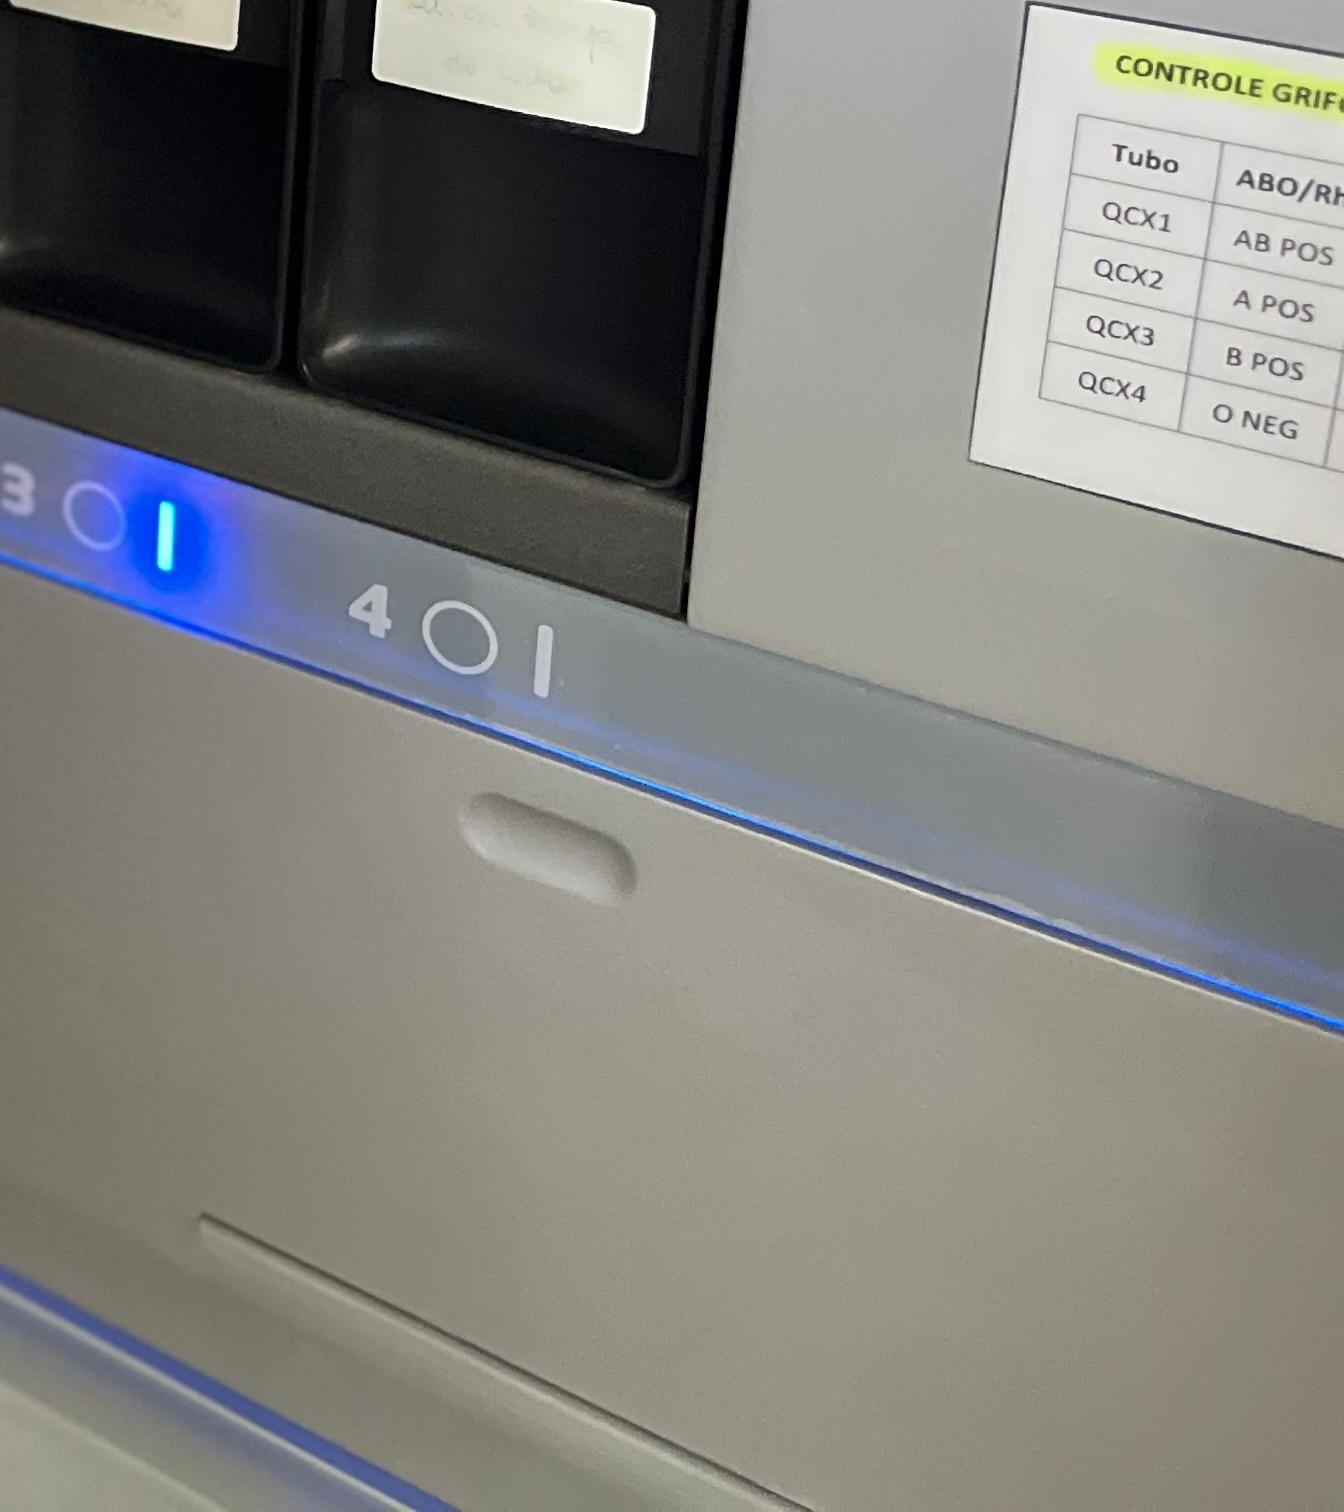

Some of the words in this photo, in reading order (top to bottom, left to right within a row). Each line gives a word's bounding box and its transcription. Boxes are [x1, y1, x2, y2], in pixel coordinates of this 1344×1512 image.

[1115, 54, 1265, 98] CONTROLE
[1272, 82, 1344, 114] GRIF
[1112, 143, 1180, 174] Tubo
[1102, 201, 1172, 234] QCX1
[1233, 229, 1271, 253] AB
[1280, 238, 1335, 267] POS
[1093, 258, 1164, 290] QCX2
[1232, 289, 1252, 310] A
[1261, 294, 1316, 324] POS
[1085, 314, 1156, 347] QCX3
[1225, 346, 1243, 367] B
[1251, 352, 1305, 382] POS
[1078, 371, 1147, 404] QCX4
[1211, 403, 1234, 424] O
[1241, 410, 1300, 441] NEG
[1, 460, 35, 517] 3
[348, 583, 392, 640] 4
